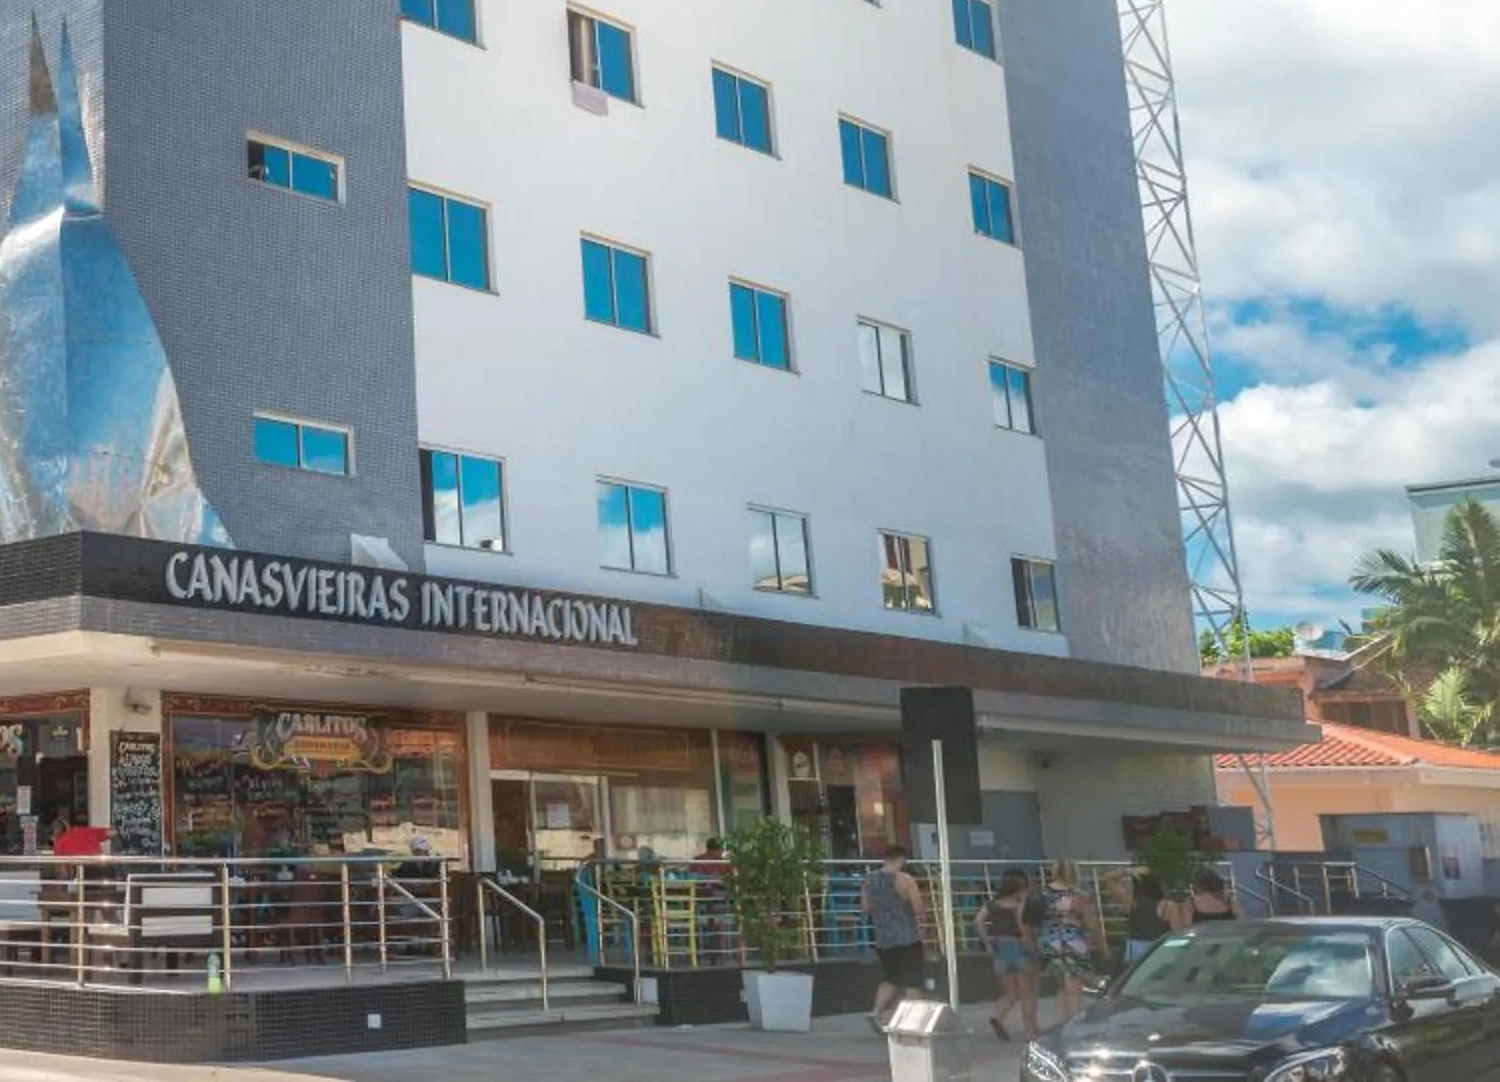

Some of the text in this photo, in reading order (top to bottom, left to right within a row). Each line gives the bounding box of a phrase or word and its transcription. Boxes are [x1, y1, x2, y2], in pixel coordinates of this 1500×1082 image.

[165, 550, 639, 646] CANASVIEIRAS INTERNACIONAL
[276, 712, 368, 744] CARLITOS
